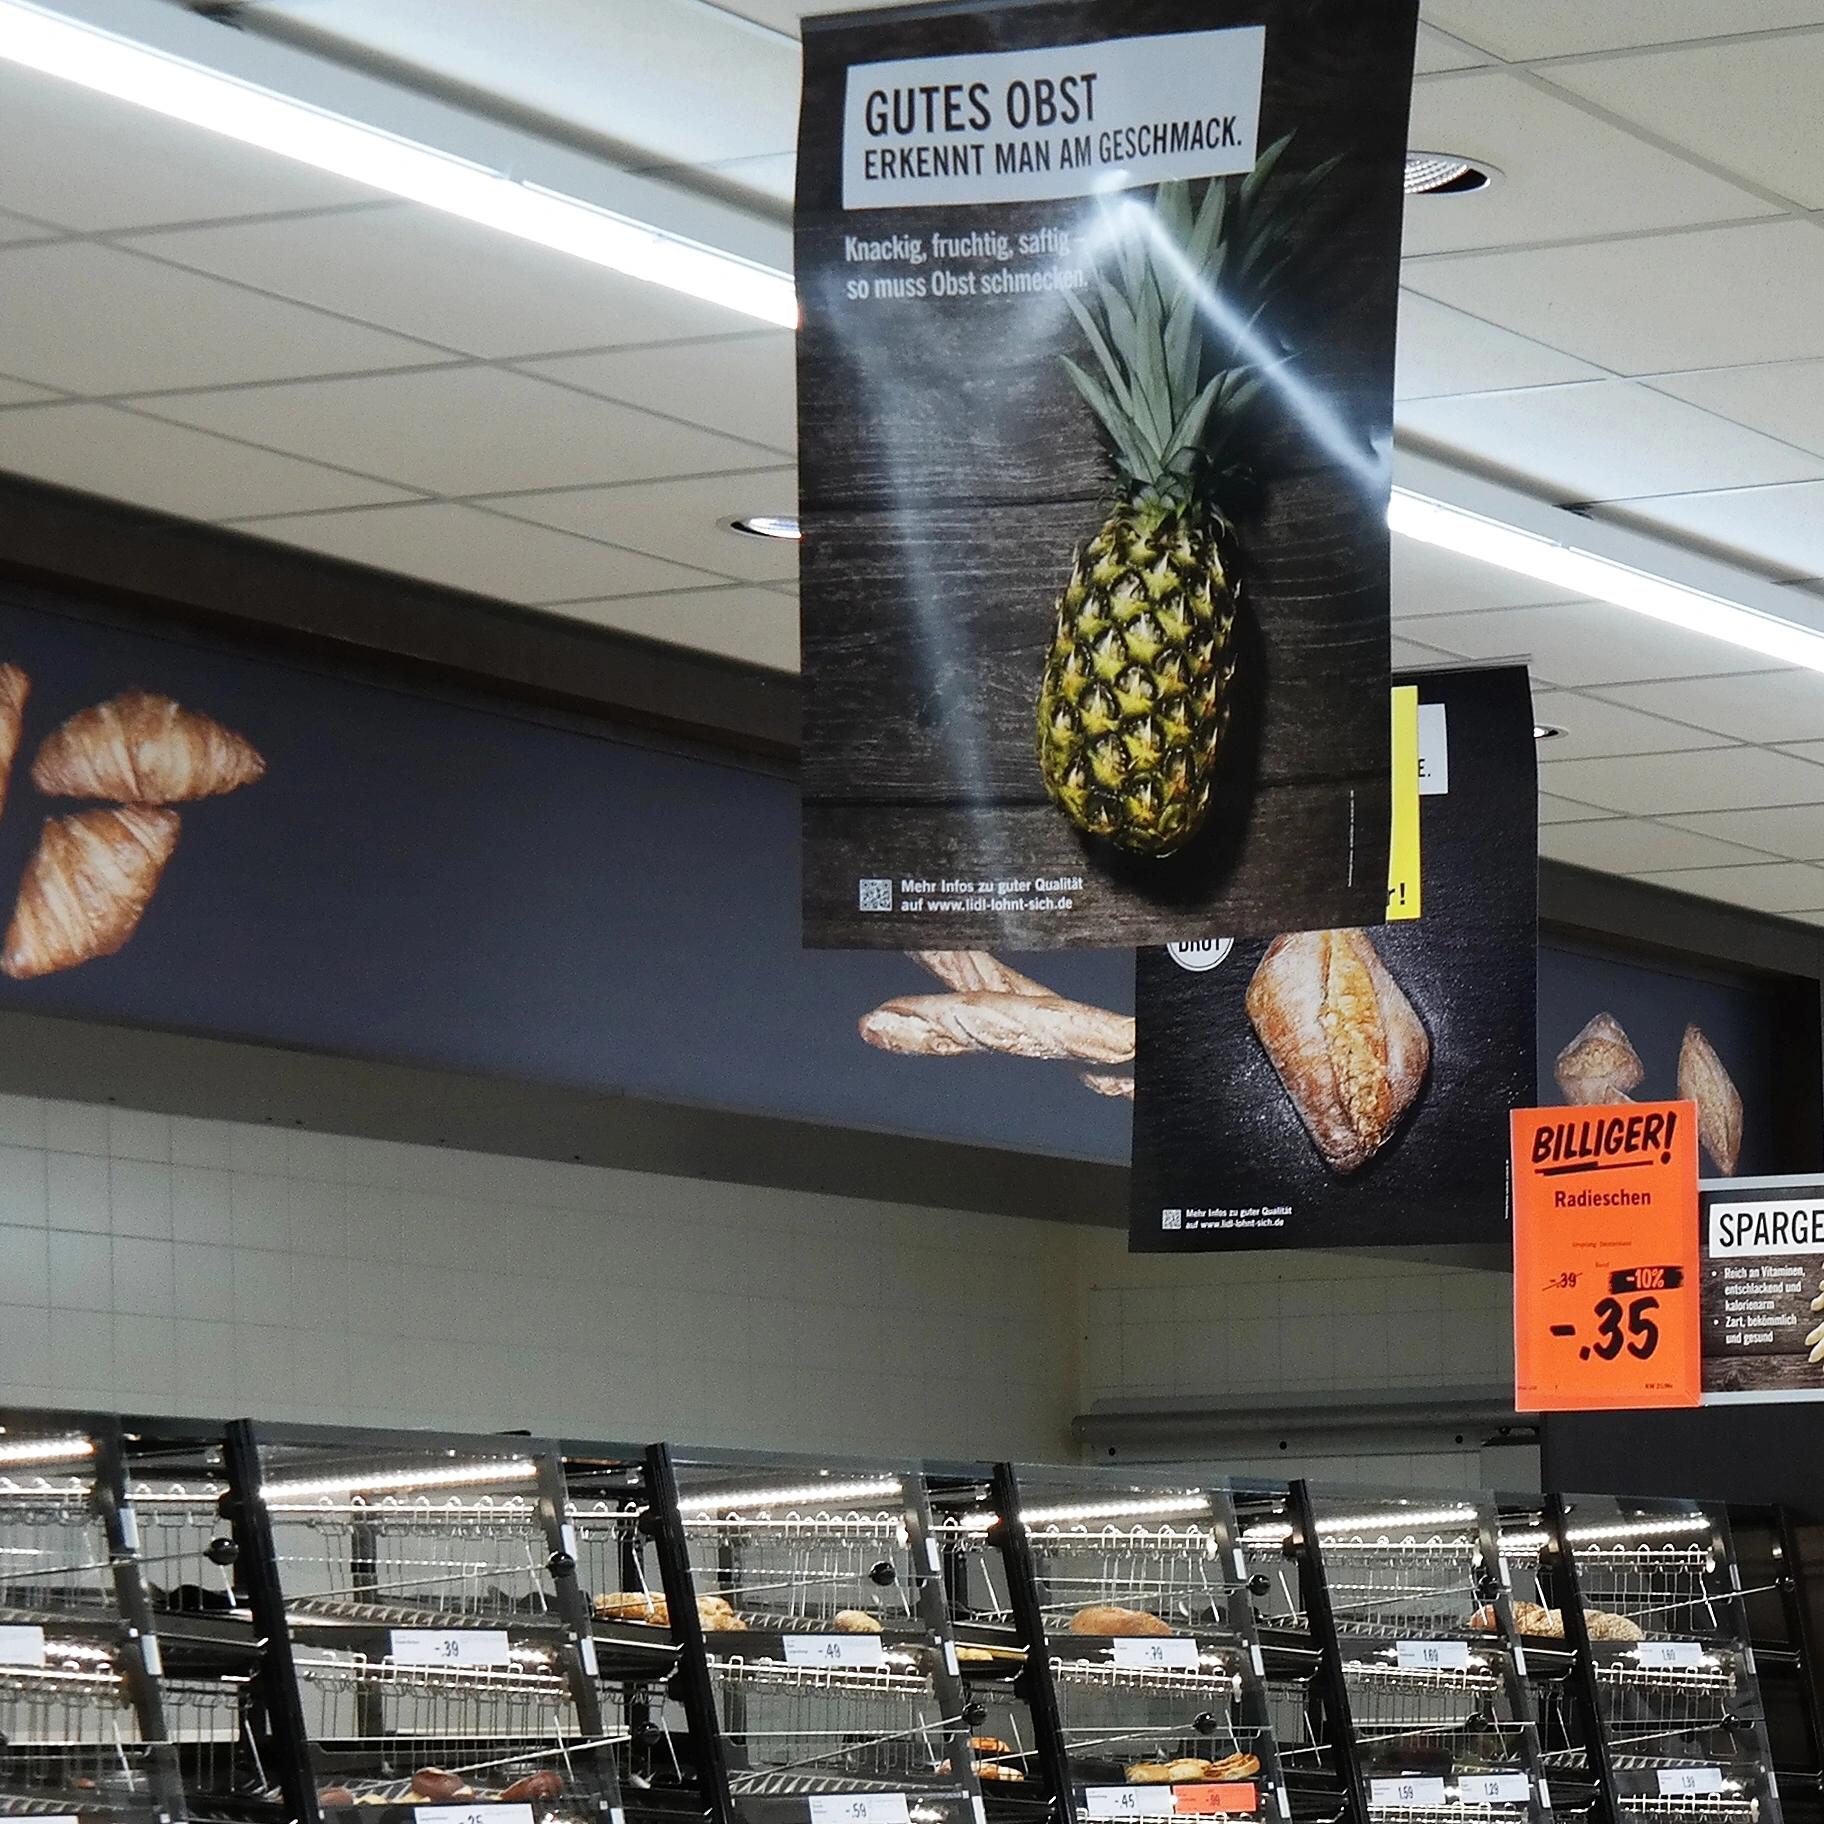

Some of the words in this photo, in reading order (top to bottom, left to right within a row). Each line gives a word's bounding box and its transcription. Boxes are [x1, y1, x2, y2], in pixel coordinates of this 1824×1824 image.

[865, 82, 991, 136] GUTES
[1006, 73, 1098, 129] OBST
[865, 144, 984, 180] ERKENNT
[995, 139, 1051, 174] MAN
[1059, 135, 1093, 170] AM
[1099, 116, 1243, 163] GESCHMACK.
[845, 236, 928, 263] Knackig,
[932, 230, 1013, 261] fruchtig,
[1018, 226, 1070, 257] saftig
[846, 279, 869, 300] so
[874, 276, 926, 299] muss
[931, 270, 977, 297] Obst
[980, 266, 1088, 296] schmecken.
[901, 879, 936, 893] Mehr
[941, 879, 975, 893] Infos
[978, 881, 994, 893] zu
[997, 880, 1032, 895] guter
[1034, 877, 1084, 891] Qualität
[901, 898, 924, 912] auf
[927, 896, 1073, 912] www.lidl-lohnt-sich.de
[1531, 1110, 1677, 1165] BILLIGER!
[1554, 1189, 1652, 1208] Radieschen
[1625, 1268, 1665, 1290] -10%
[1549, 1296, 1660, 1361] -.35
[434, 1641, 460, 1658] -.39
